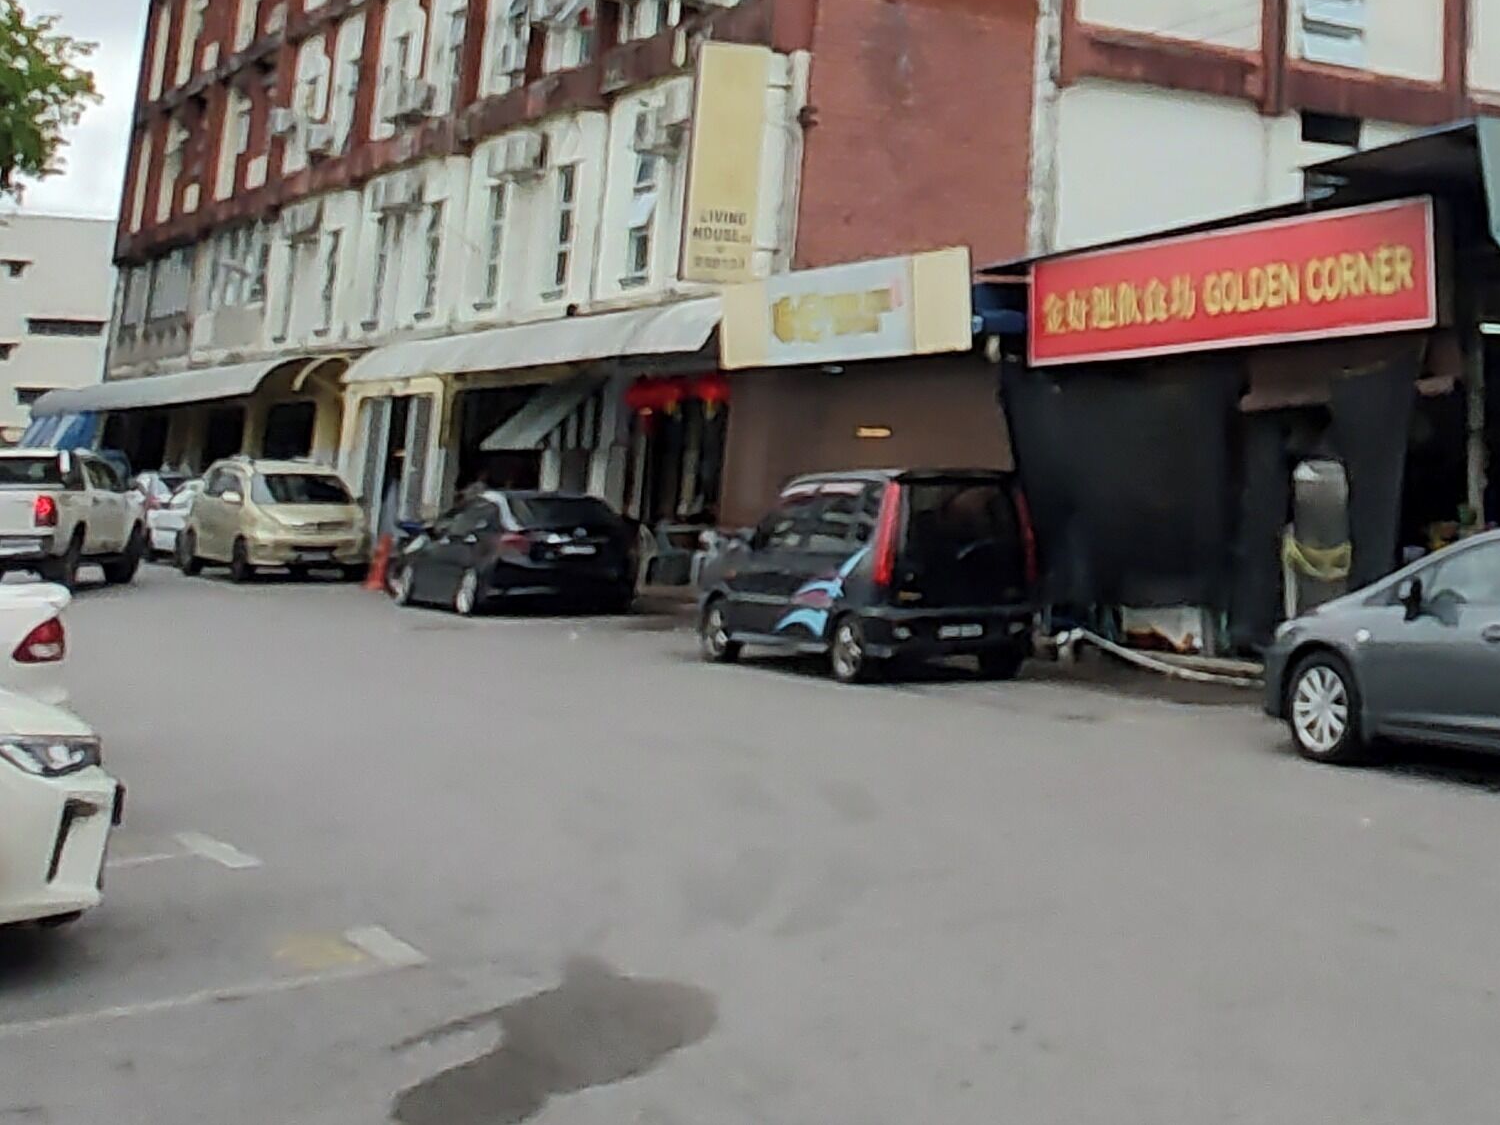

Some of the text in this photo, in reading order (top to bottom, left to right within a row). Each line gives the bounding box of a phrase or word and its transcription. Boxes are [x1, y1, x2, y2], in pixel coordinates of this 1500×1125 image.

[699, 209, 747, 226] LIVING
[1204, 246, 1414, 315] GOLDEN CORNER
